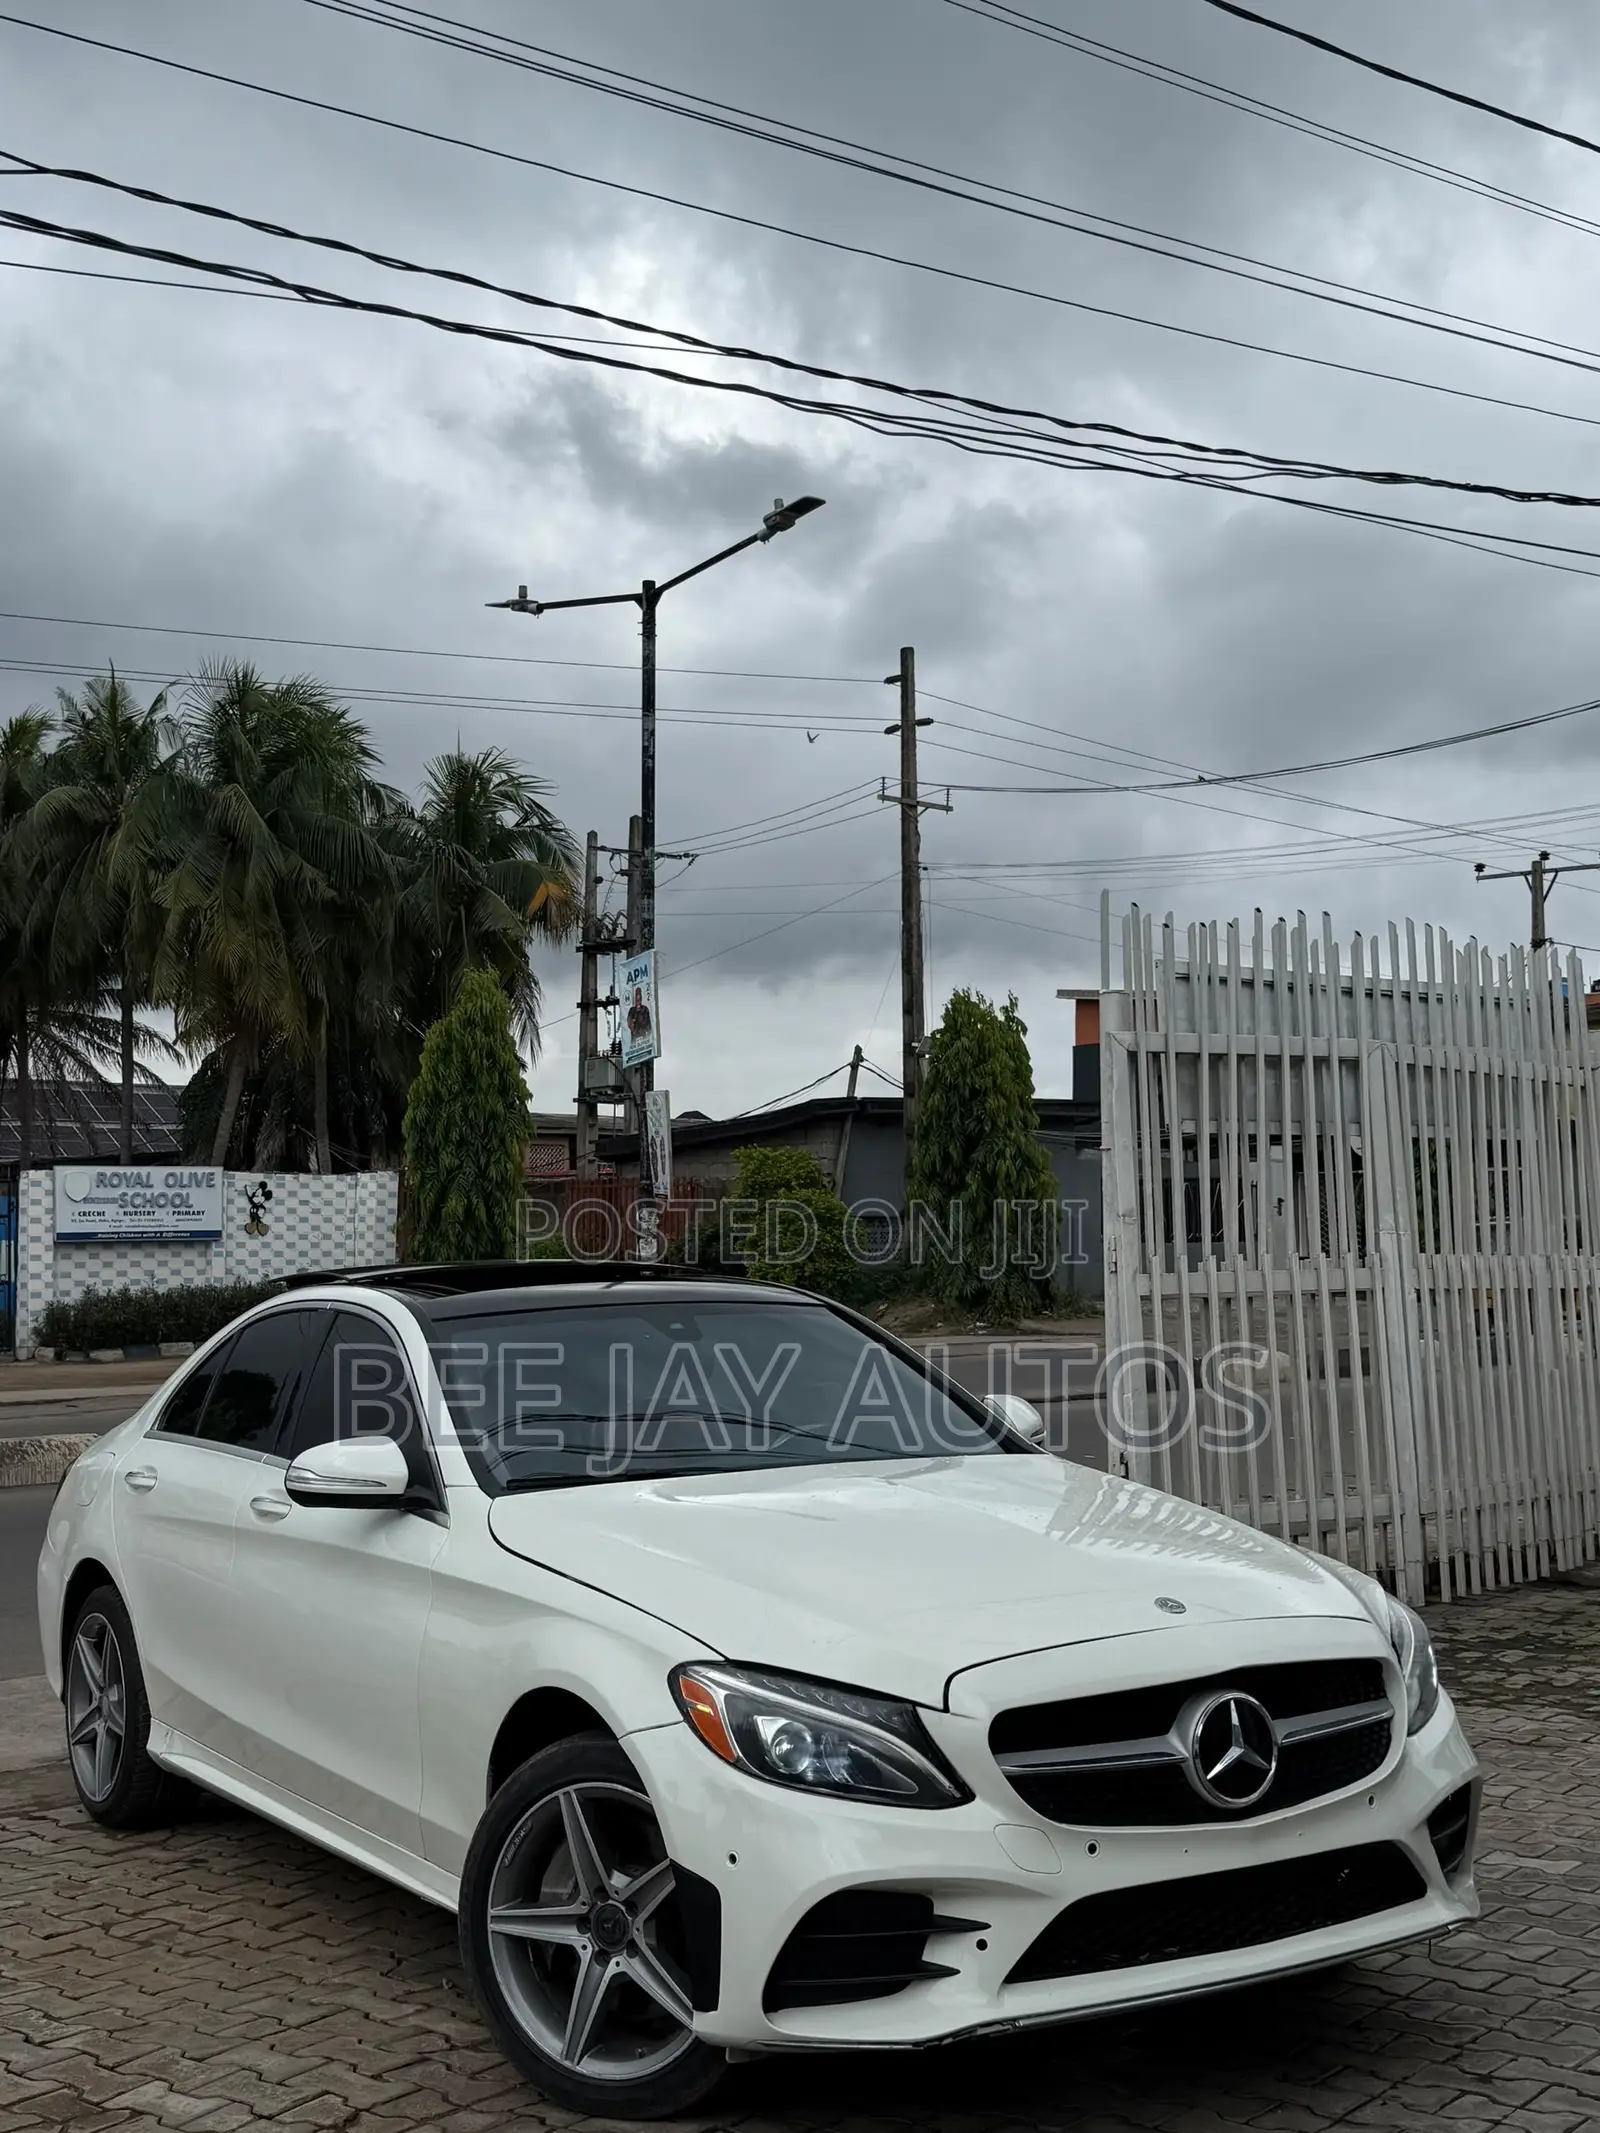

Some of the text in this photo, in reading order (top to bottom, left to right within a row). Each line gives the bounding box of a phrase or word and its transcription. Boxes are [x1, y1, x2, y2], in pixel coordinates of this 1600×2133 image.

[626, 964, 649, 985] APM
[96, 1171, 216, 1188] ROYAL OLIVE
[118, 1192, 194, 1209] SCHOOL
